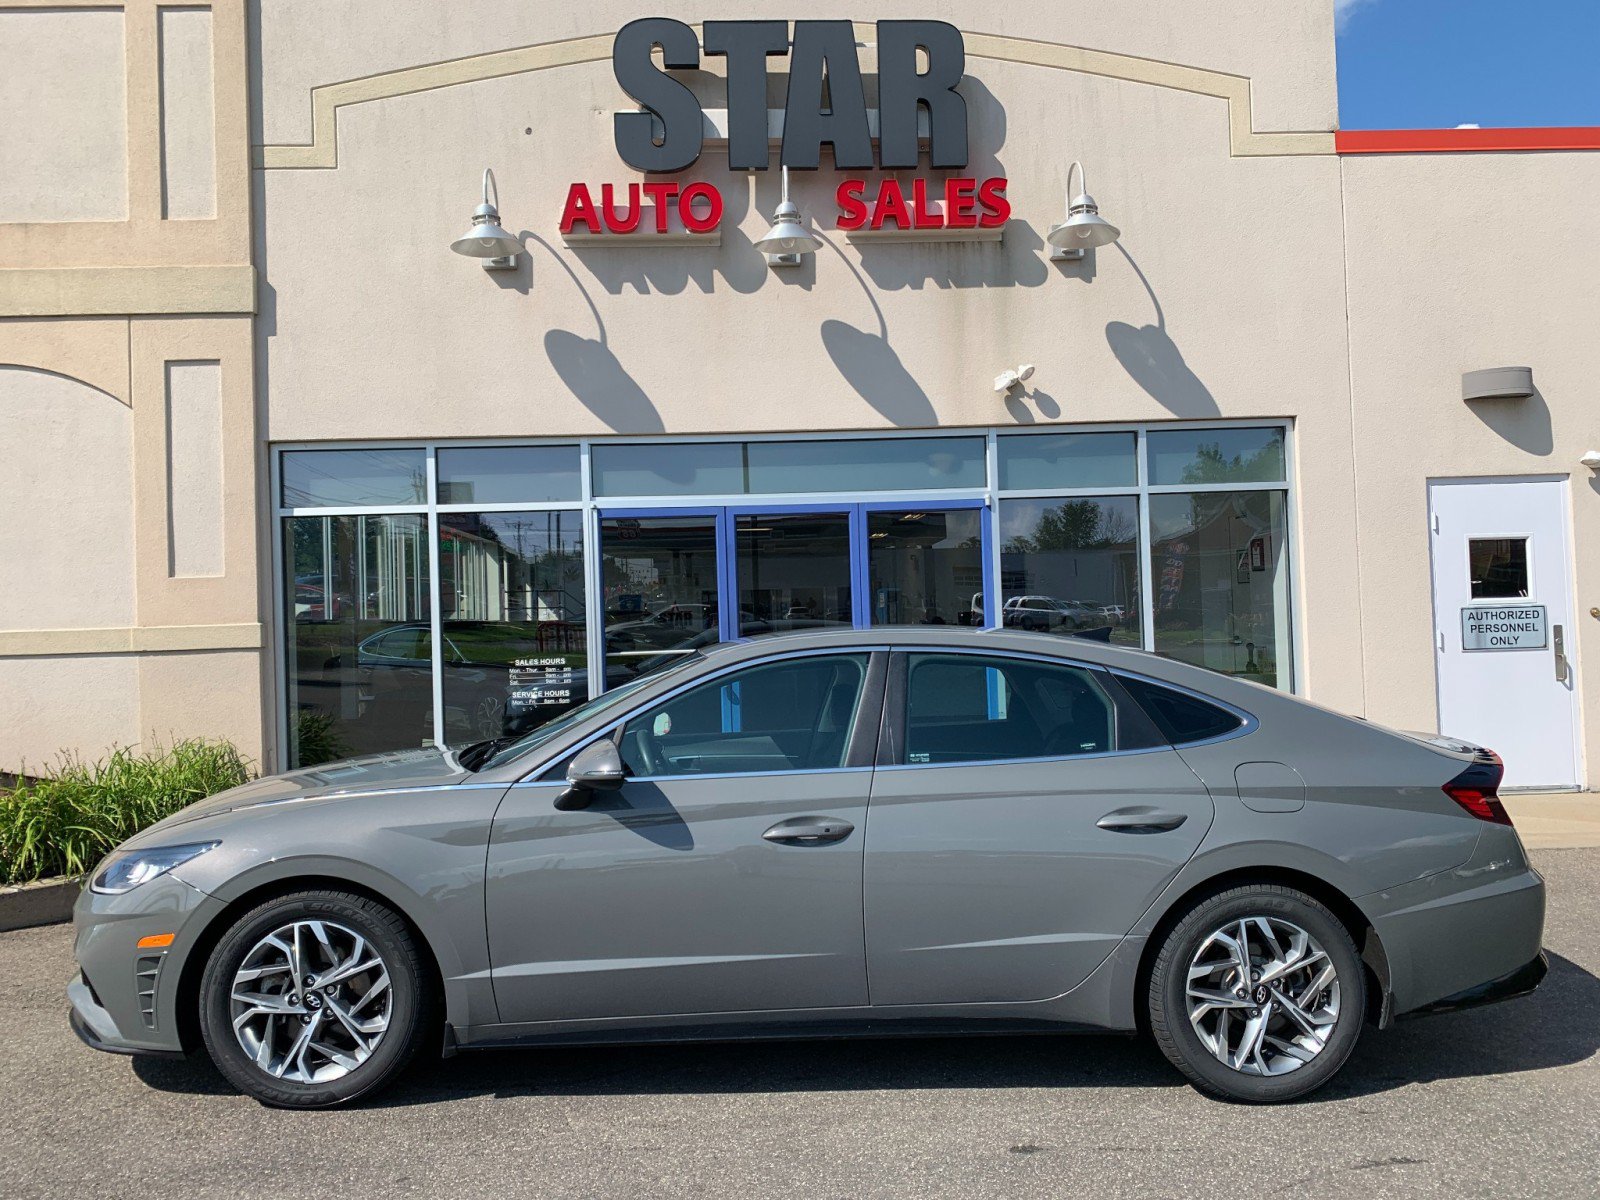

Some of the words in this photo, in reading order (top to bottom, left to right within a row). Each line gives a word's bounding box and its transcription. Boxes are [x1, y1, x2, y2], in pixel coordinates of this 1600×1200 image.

[613, 17, 968, 172] STAR
[559, 182, 723, 234] AUTO
[836, 178, 1011, 230] SALES
[1468, 610, 1540, 621] AUTHORIZED
[1470, 623, 1538, 633] PERSONNEL
[1490, 636, 1520, 646] ONLY
